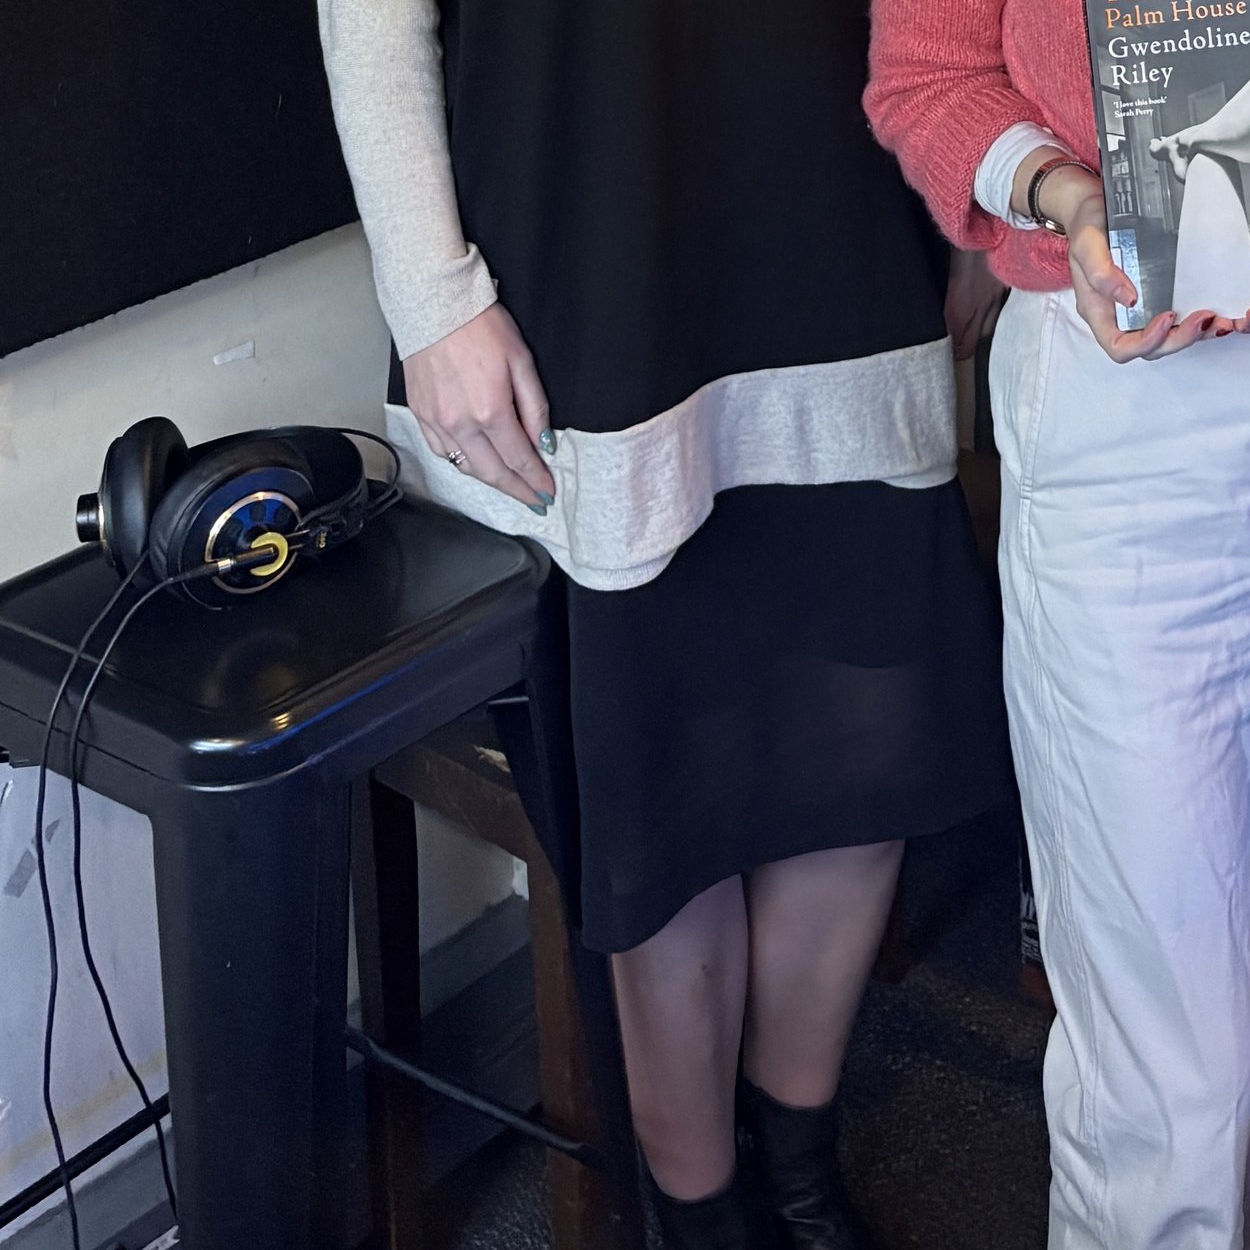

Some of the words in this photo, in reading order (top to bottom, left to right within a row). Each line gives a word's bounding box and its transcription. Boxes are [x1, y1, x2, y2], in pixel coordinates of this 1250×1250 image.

[1104, 5, 1165, 29] Palm
[1108, 26, 1250, 58] Gwendoline
[1111, 61, 1174, 88] Riley
